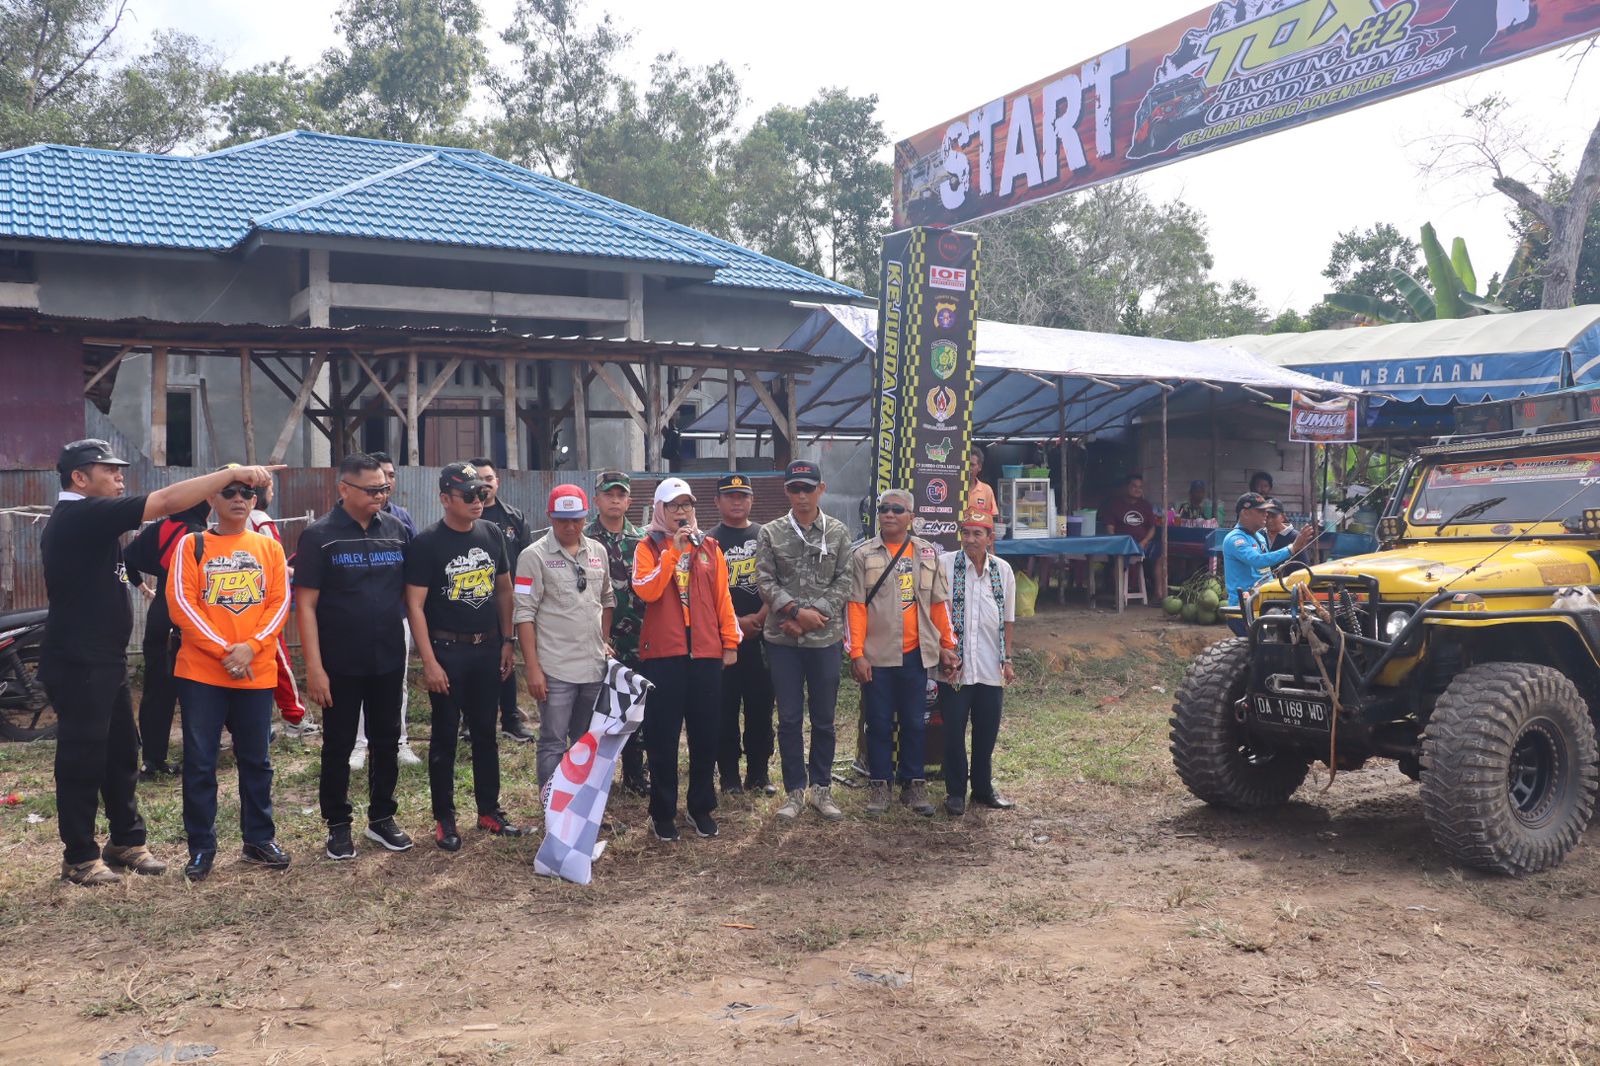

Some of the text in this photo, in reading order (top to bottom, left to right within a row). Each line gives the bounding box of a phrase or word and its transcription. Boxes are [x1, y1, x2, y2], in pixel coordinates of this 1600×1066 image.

[1203, 0, 1382, 88] TOX
[1349, 1, 1415, 54] #2
[1180, 48, 1452, 148] KEJURDA RACING ADVENTURE 2024
[1205, 41, 1421, 124] OFFROAD EXTREME
[939, 44, 1126, 210] START
[930, 267, 966, 280] IOF
[882, 262, 903, 389] KEJURDA
[879, 395, 896, 496] RACING
[1296, 411, 1347, 427] UMKM
[922, 521, 958, 532] CINTA
[206, 569, 263, 605] TOX
[451, 565, 495, 600] TOX
[1257, 697, 1272, 715] DA
[1278, 700, 1304, 718] 1169
